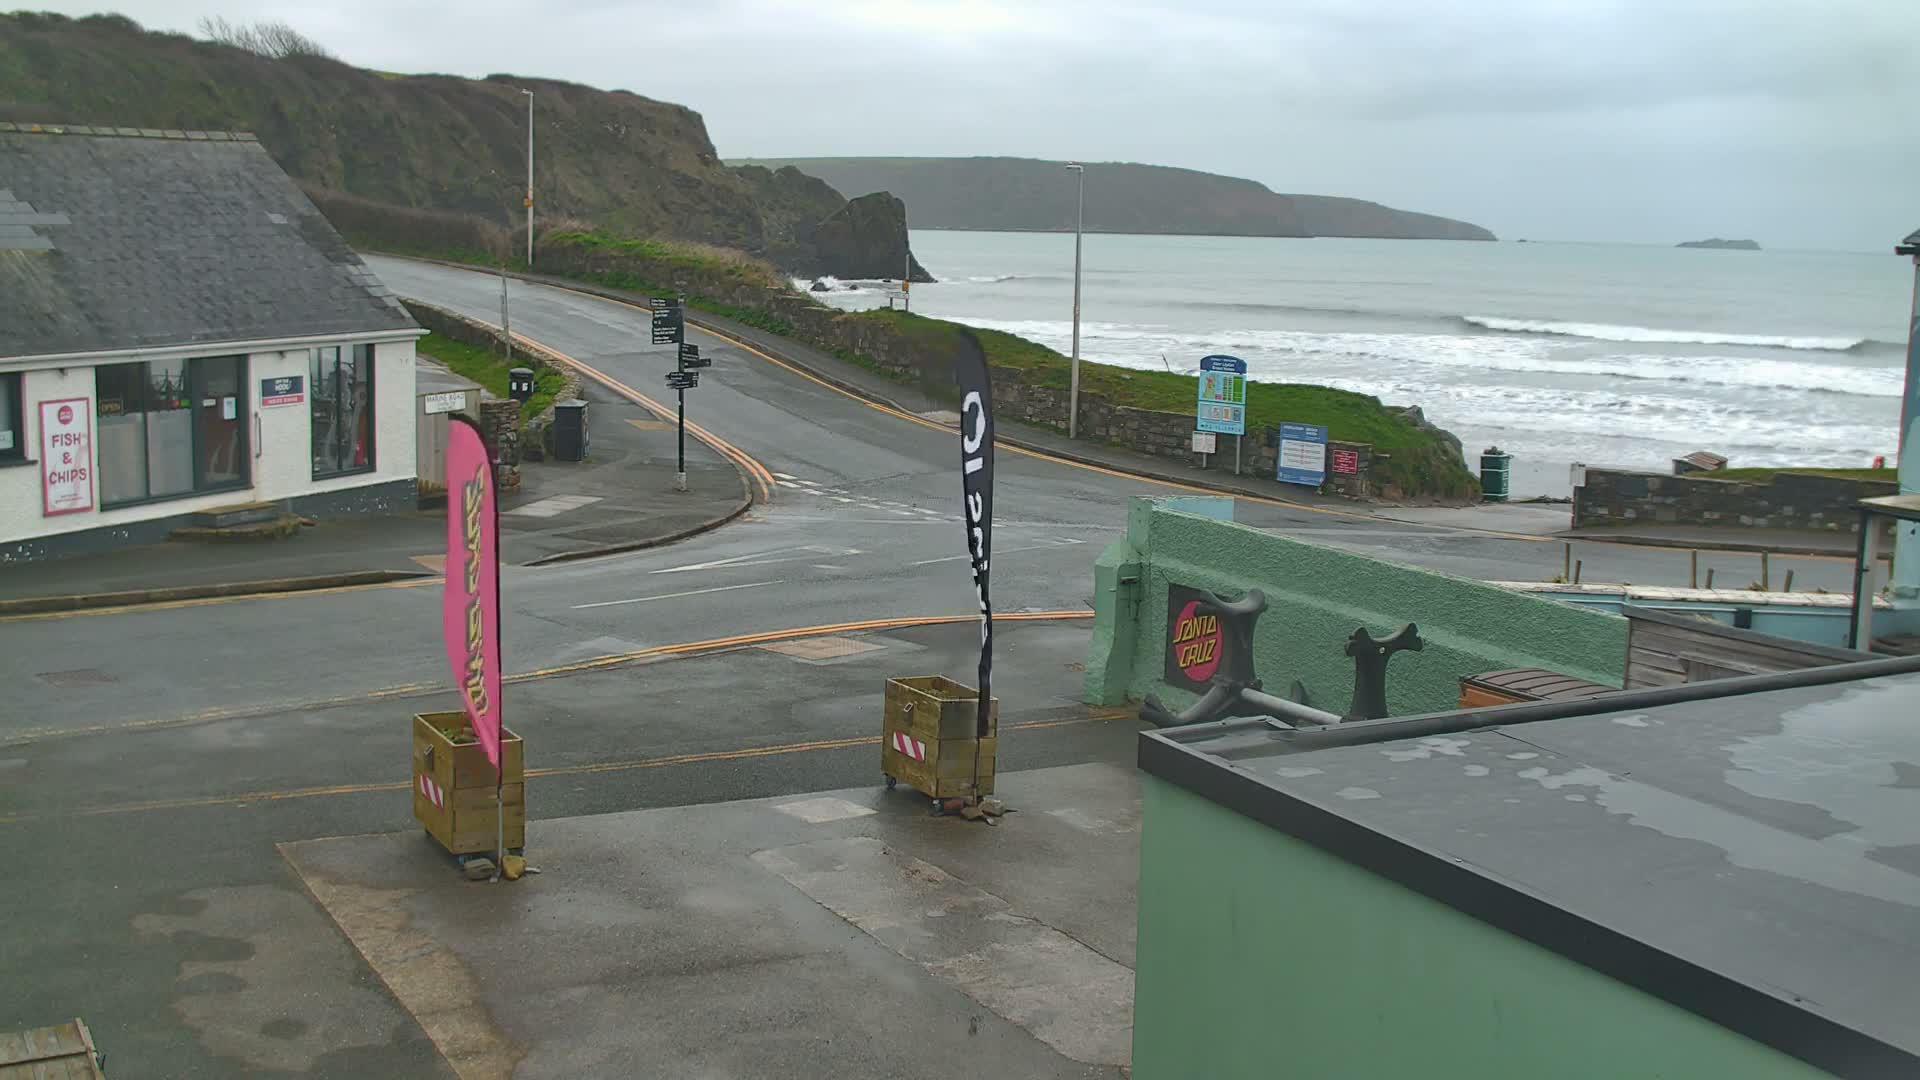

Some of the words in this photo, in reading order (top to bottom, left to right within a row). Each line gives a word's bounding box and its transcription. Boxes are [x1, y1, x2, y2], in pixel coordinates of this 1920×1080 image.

[52, 432, 81, 448] FISH
[63, 452, 72, 465] &
[49, 468, 87, 485] CHIPS
[1173, 615, 1218, 643] SANTA
[1180, 639, 1217, 668] CRUZ
